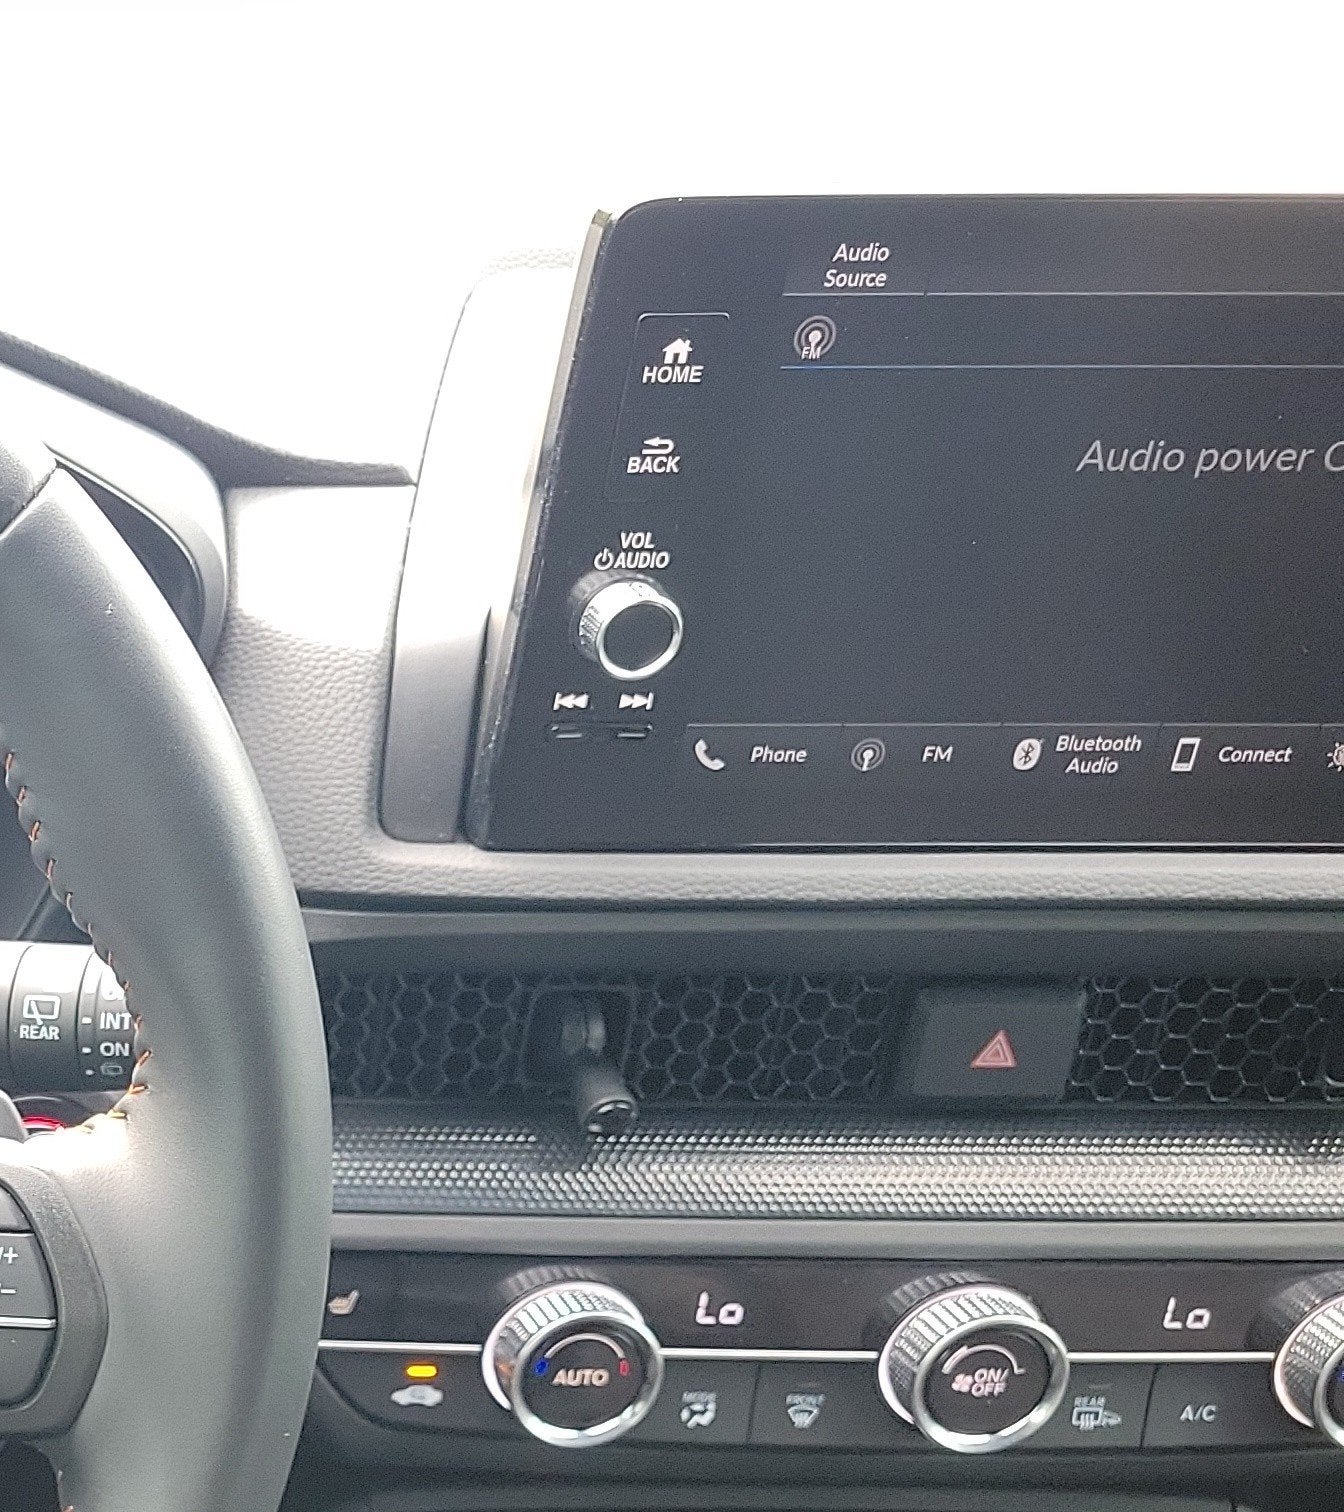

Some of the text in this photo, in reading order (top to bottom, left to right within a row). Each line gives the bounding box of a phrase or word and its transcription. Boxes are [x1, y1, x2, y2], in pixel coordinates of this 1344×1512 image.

[832, 243, 890, 263] Audio
[823, 269, 888, 288] Source
[801, 347, 822, 360] FM
[642, 365, 704, 384] HOME
[627, 456, 680, 475] BACK
[1076, 439, 1185, 473] Audio
[1194, 446, 1315, 479] power
[620, 532, 655, 549] VOL
[614, 551, 670, 569] AUDIO
[1055, 734, 1143, 753] Bluetooth
[750, 744, 808, 764] Phone
[922, 745, 954, 763] FM
[1218, 745, 1293, 764] Connect
[1065, 757, 1119, 775] Audio
[100, 1011, 132, 1030] INT
[19, 1024, 61, 1041] REAR
[99, 1041, 130, 1058] ON
[695, 1290, 745, 1326] Lo
[1162, 1297, 1212, 1330] Lo
[551, 1368, 610, 1387] AUTO
[971, 1382, 1005, 1398] OFF
[1179, 1404, 1217, 1422] A/C
